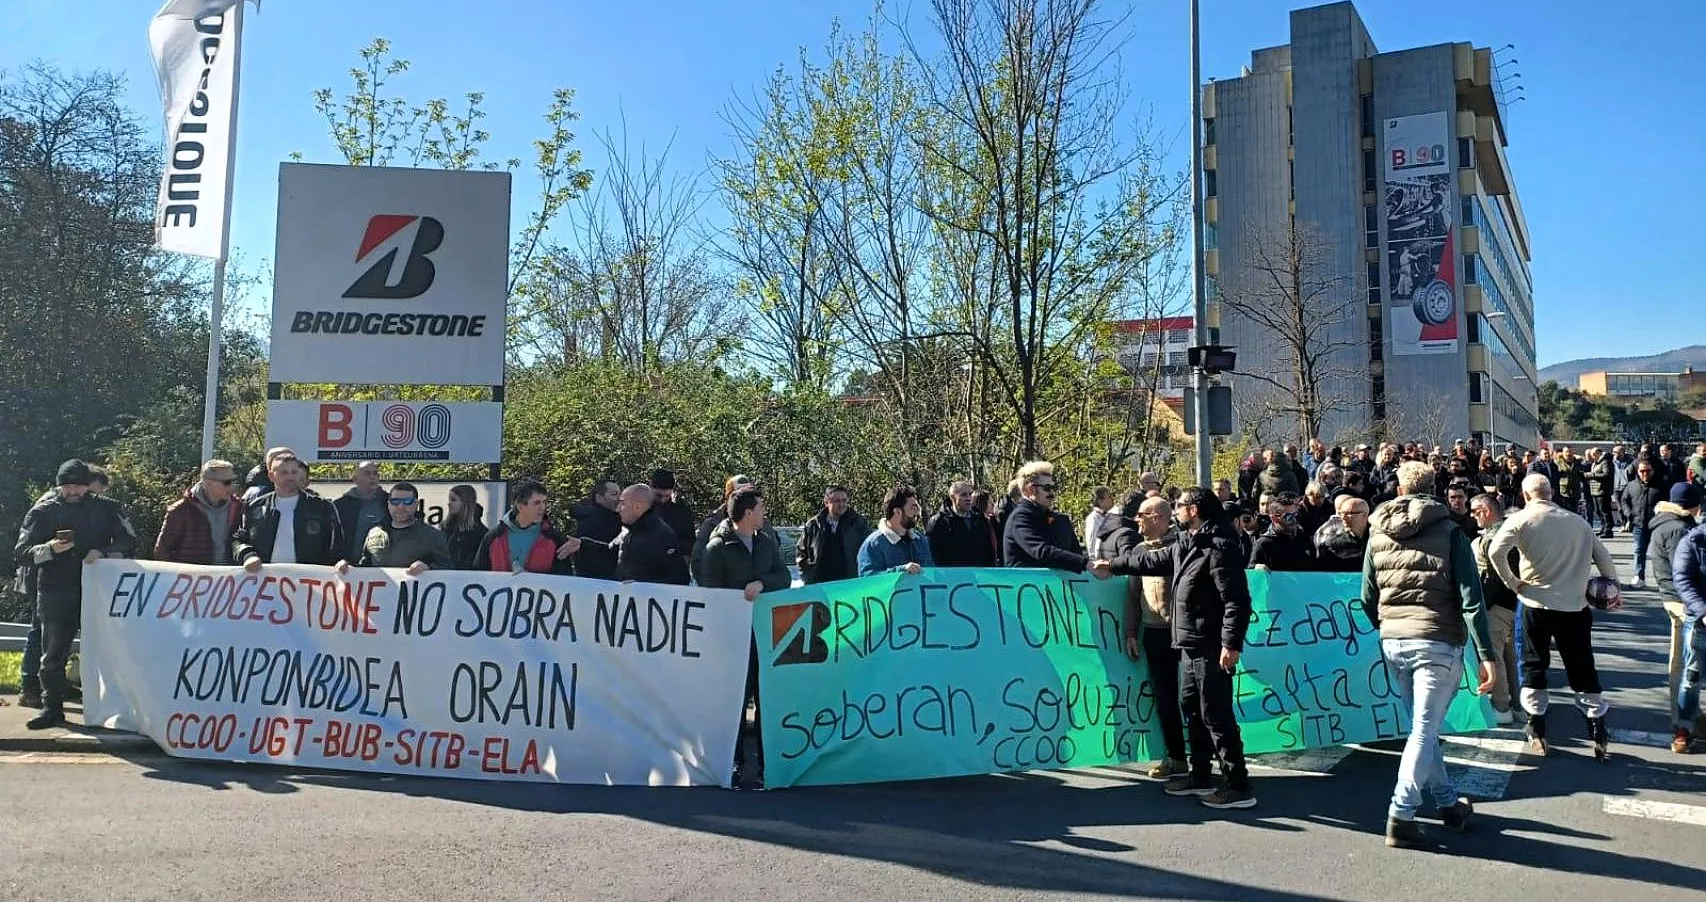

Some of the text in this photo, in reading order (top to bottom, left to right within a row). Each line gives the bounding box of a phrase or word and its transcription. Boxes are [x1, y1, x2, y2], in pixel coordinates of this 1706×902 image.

[290, 311, 487, 337] BRIDGESTONE
[318, 403, 451, 449] B 90
[108, 572, 706, 658] EN BRIDGESTONE NO SOBRA NADIE
[173, 647, 577, 730] KONPONBIDEA ORAIN
[993, 702, 1410, 769] CCOO UGT SITB EL
